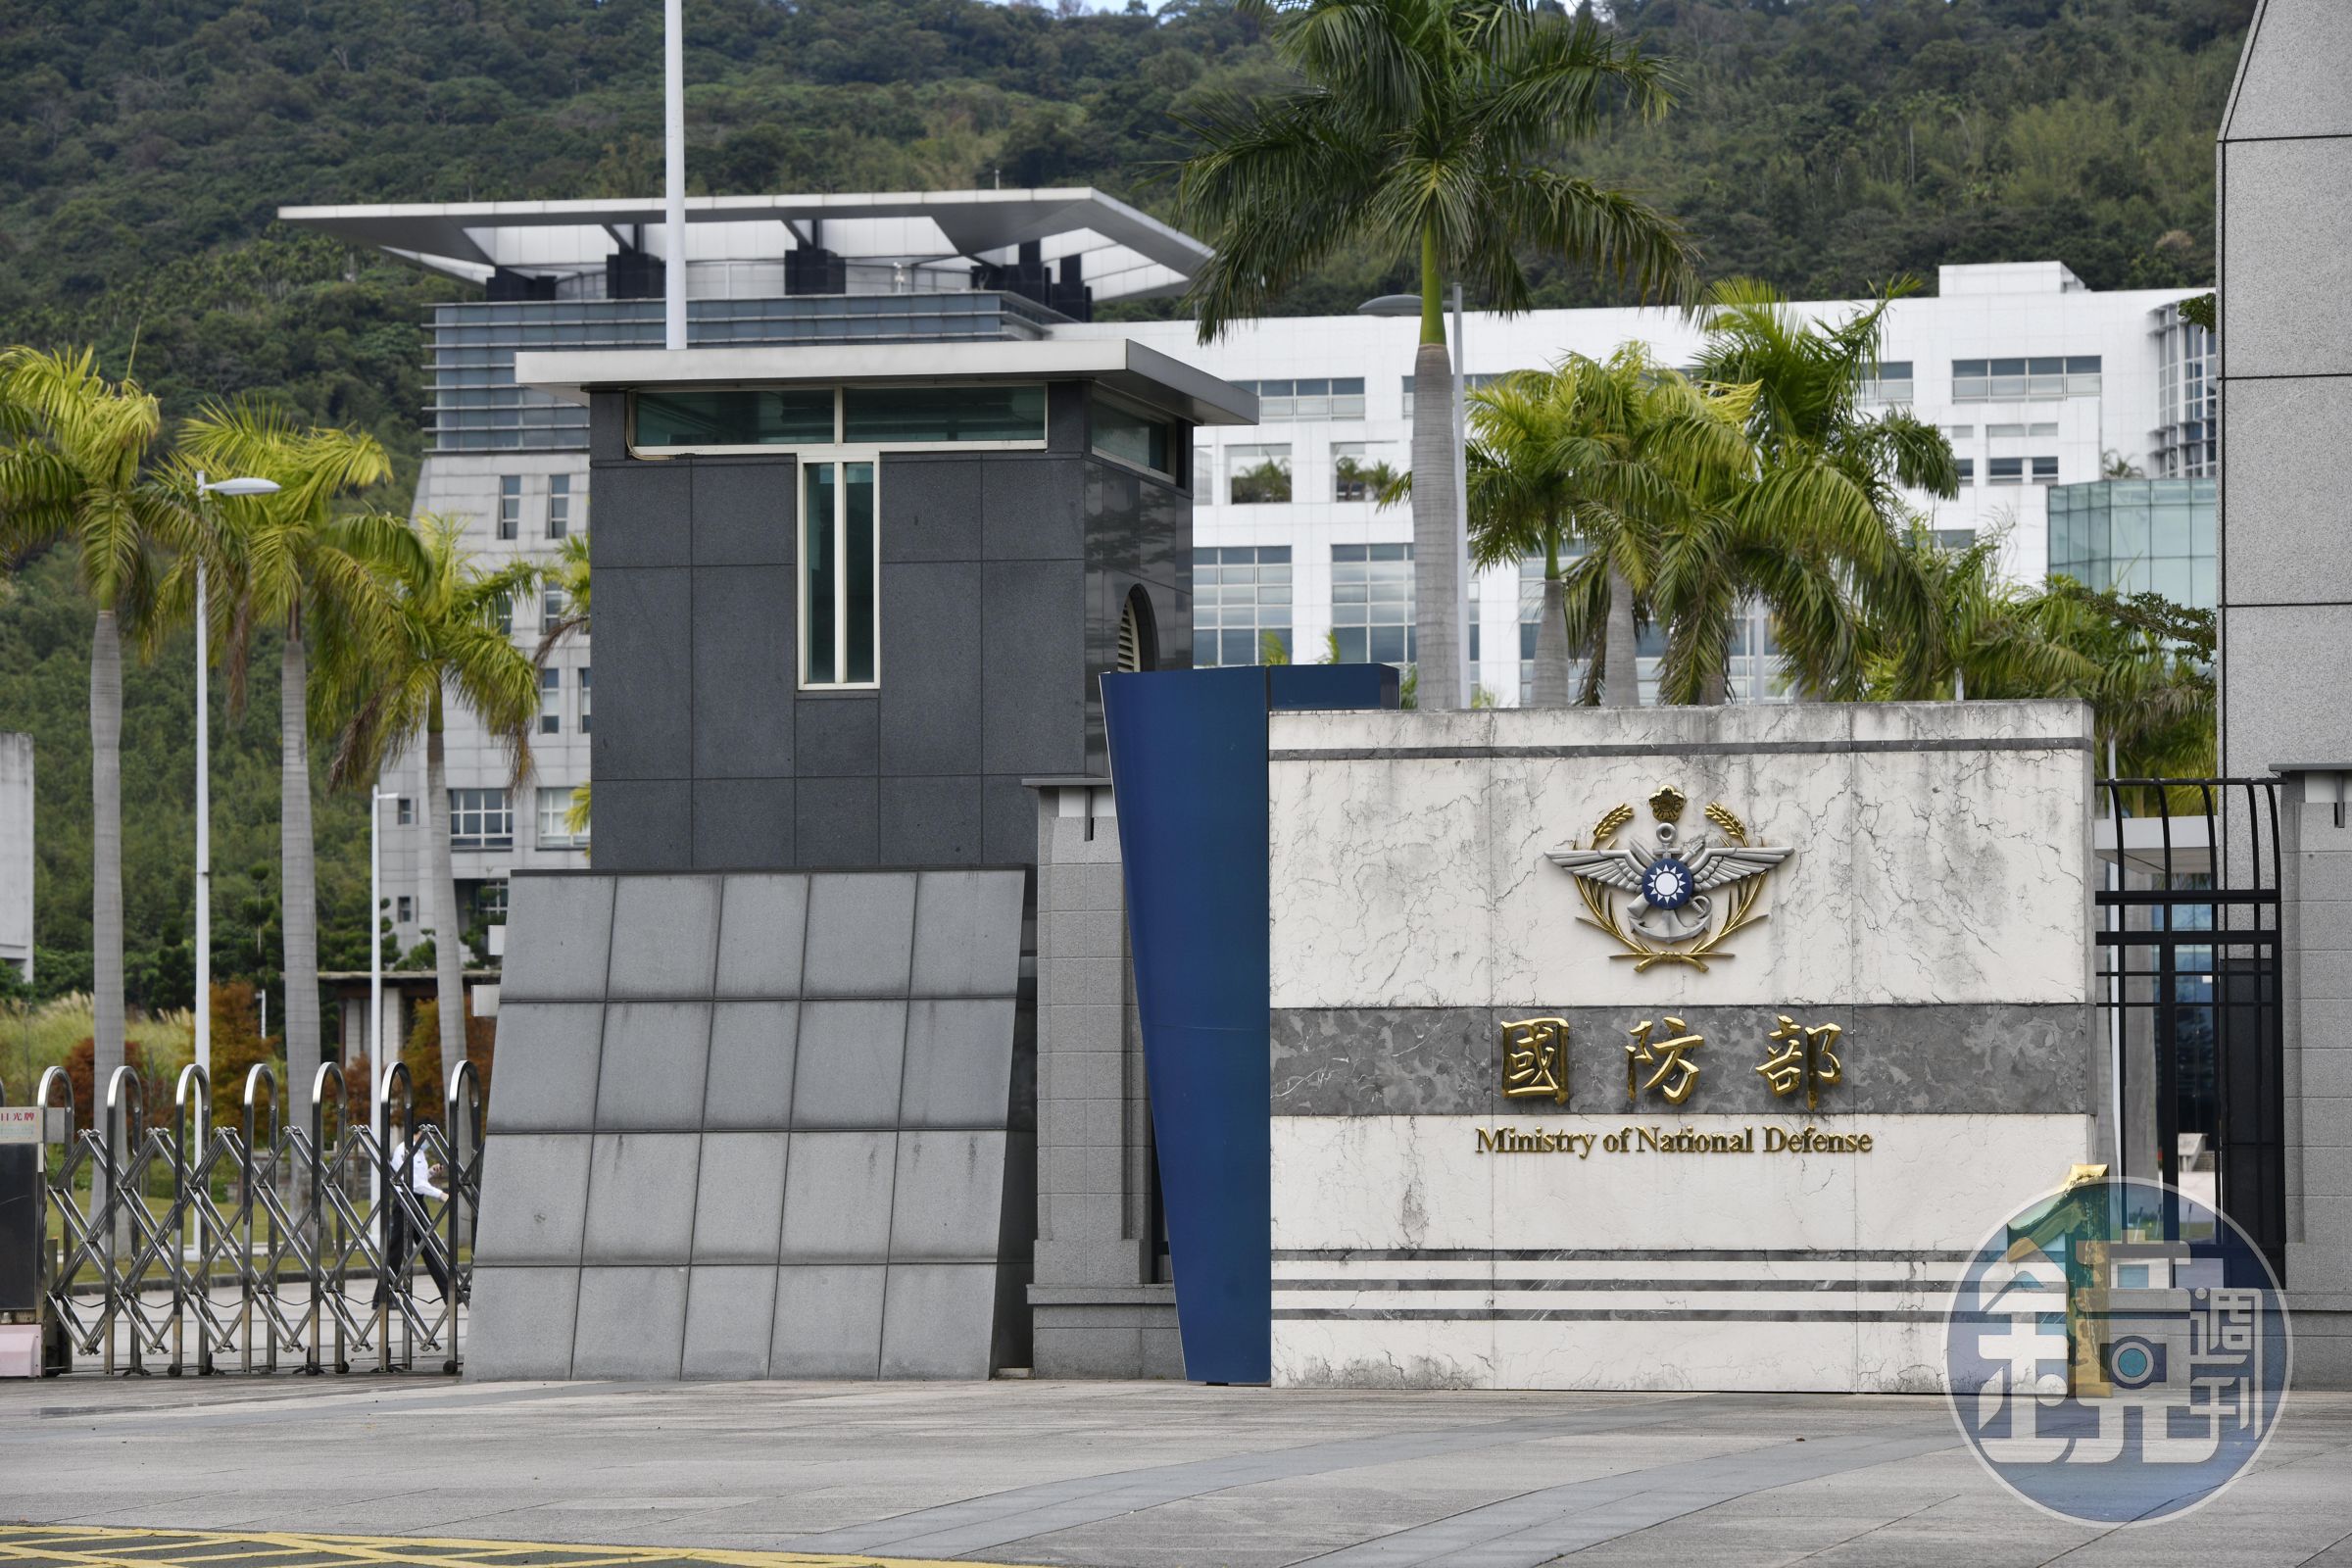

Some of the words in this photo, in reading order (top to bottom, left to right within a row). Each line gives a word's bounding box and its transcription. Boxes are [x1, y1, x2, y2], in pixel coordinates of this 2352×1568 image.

[1500, 1015, 1842, 1111] 國防部
[1475, 1126, 1596, 1159] Ministry
[1603, 1126, 1633, 1153] of
[1636, 1125, 1754, 1153] National
[1762, 1125, 1873, 1153] Defense
